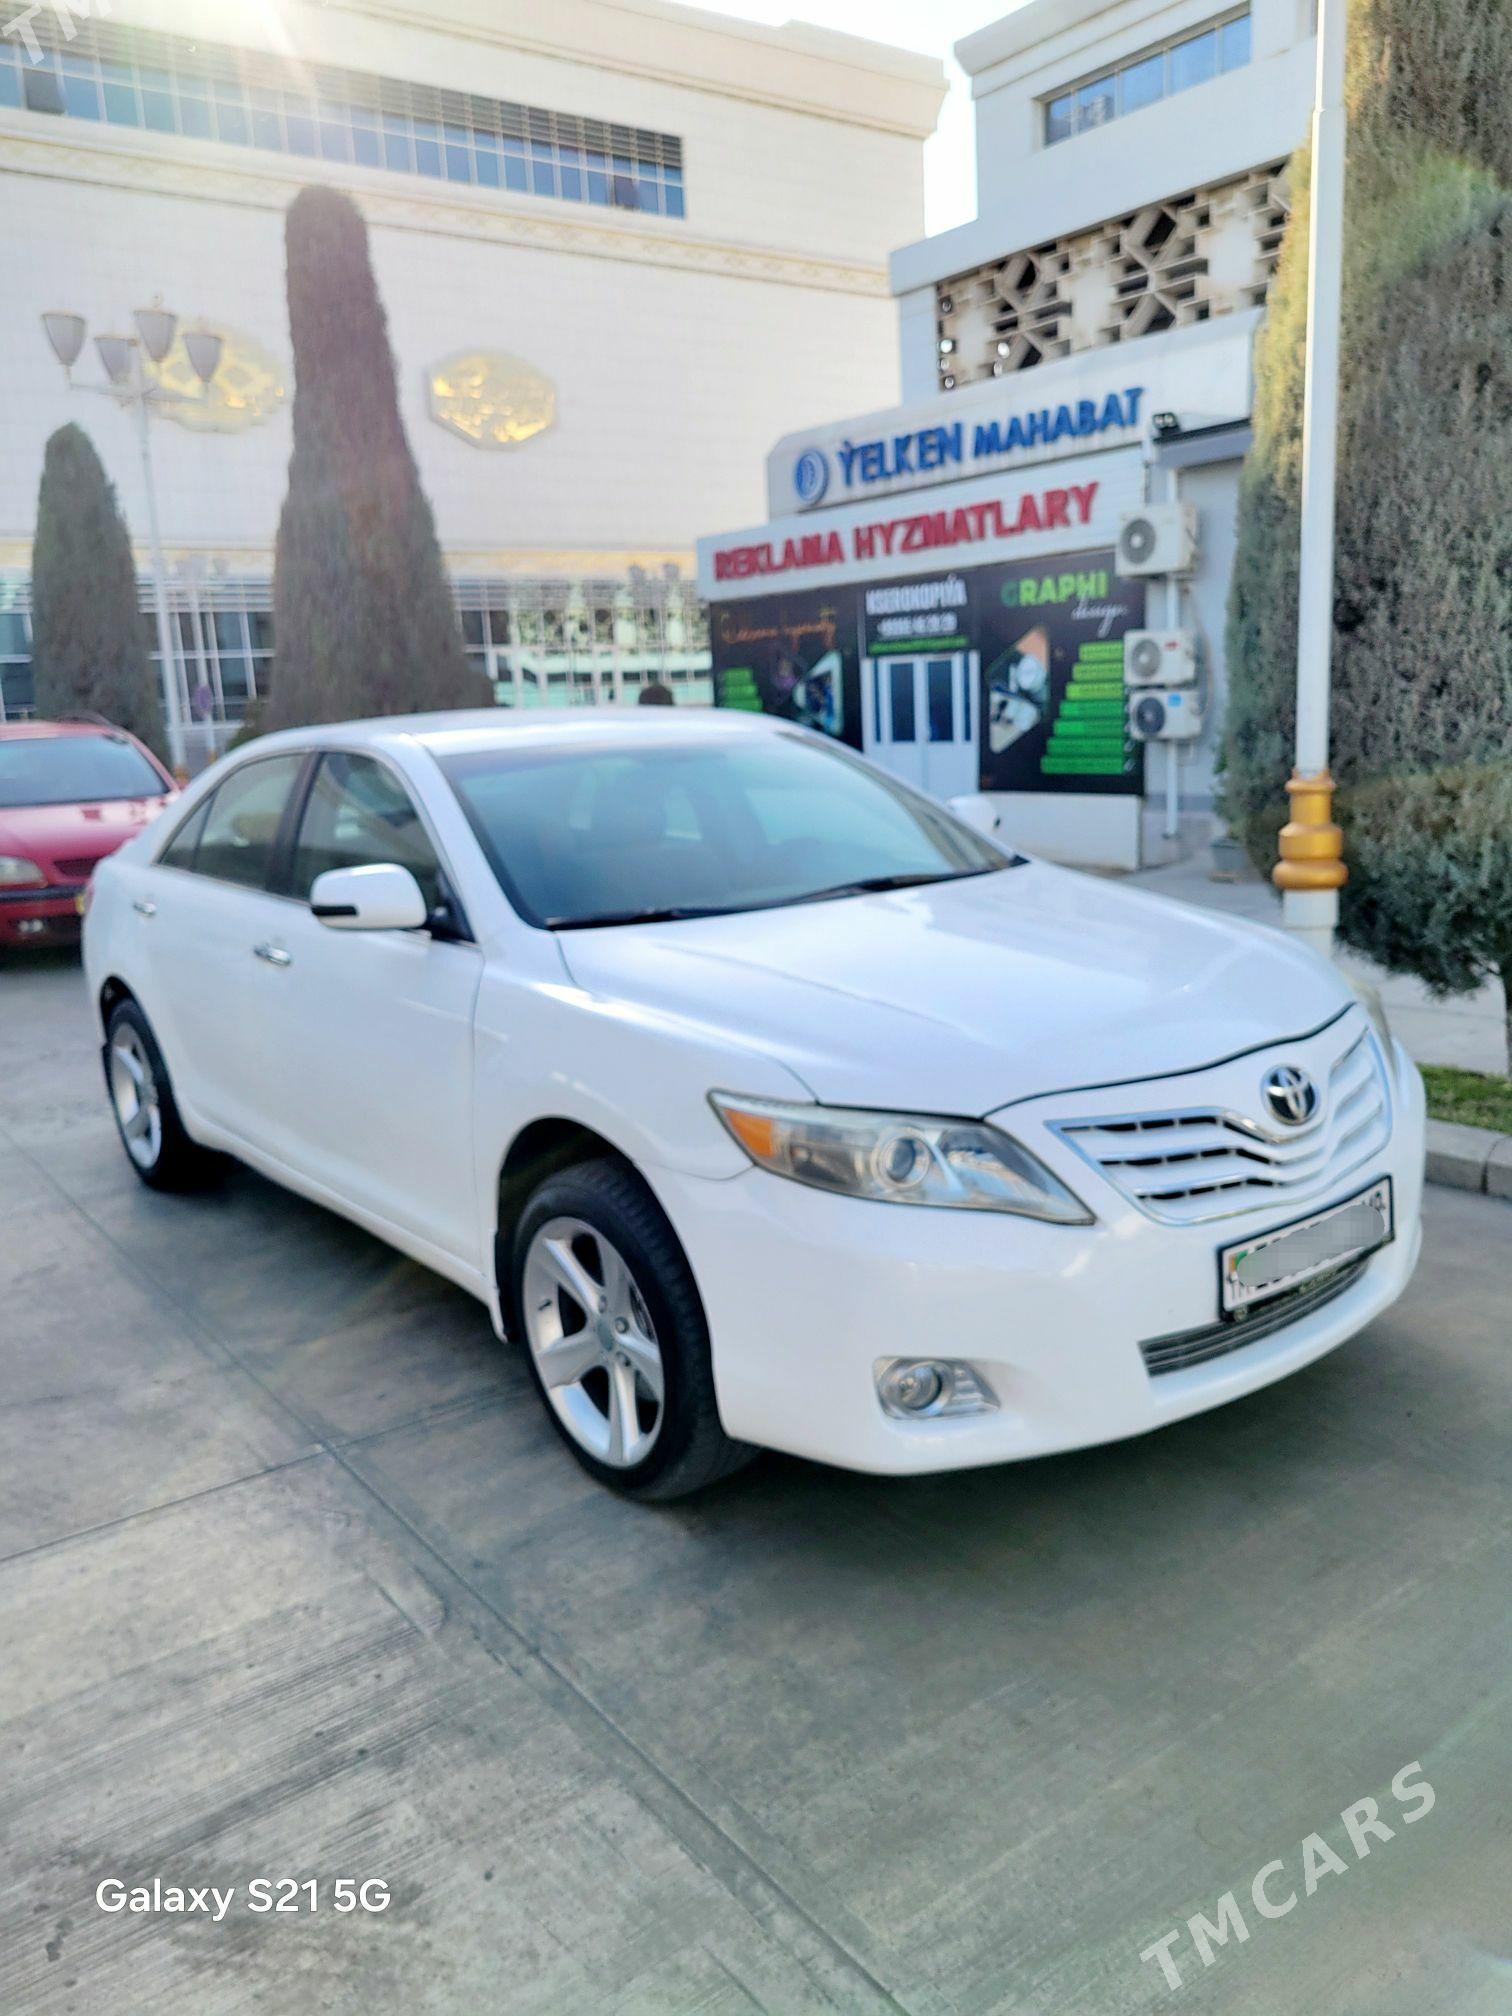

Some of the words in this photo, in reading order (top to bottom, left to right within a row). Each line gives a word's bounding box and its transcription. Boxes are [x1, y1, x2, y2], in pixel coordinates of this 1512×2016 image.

[973, 387, 1144, 459] MAHABAT
[713, 528, 844, 582] REKLAMA
[853, 482, 1099, 561] HYZMATLARY
